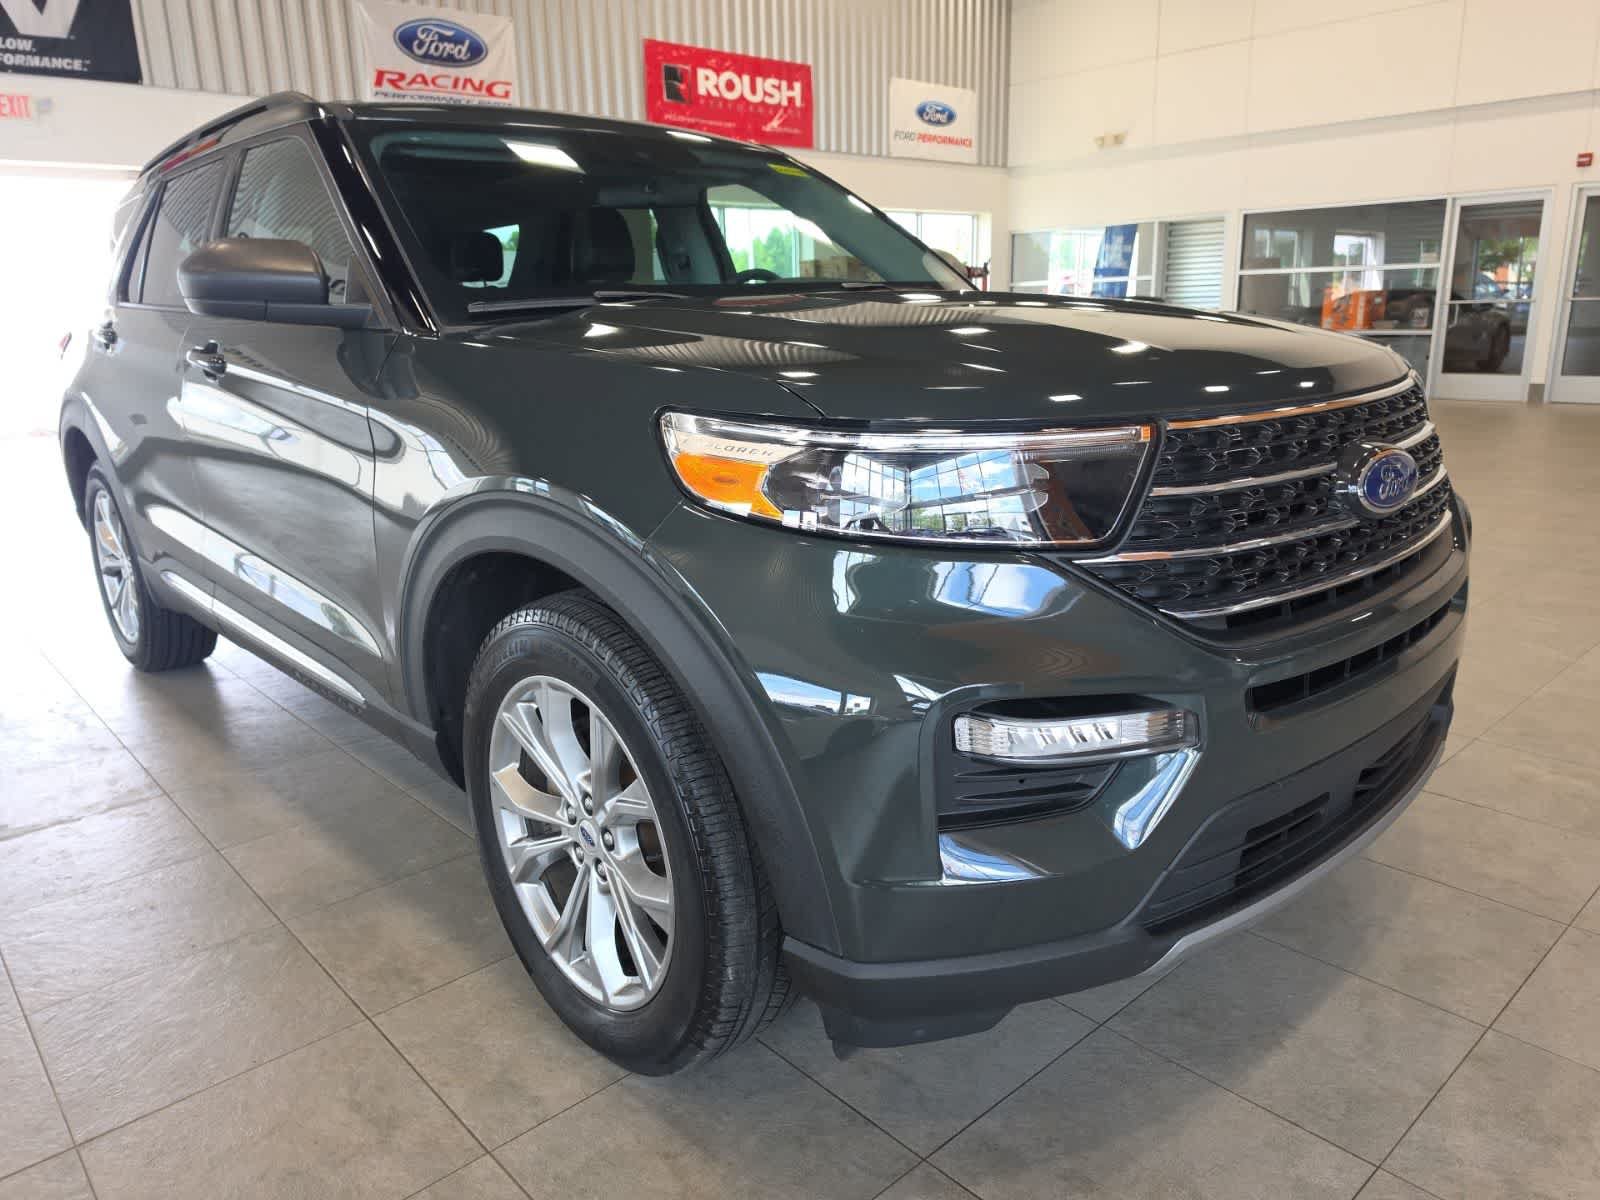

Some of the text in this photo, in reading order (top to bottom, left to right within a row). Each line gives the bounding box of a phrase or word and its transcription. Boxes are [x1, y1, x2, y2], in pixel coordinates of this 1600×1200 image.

[413, 25, 470, 60] Ford
[374, 68, 512, 99] RACING
[696, 67, 802, 108] ROUSH
[922, 104, 949, 123] Ford
[894, 130, 973, 149] FORD PERFORMANCE
